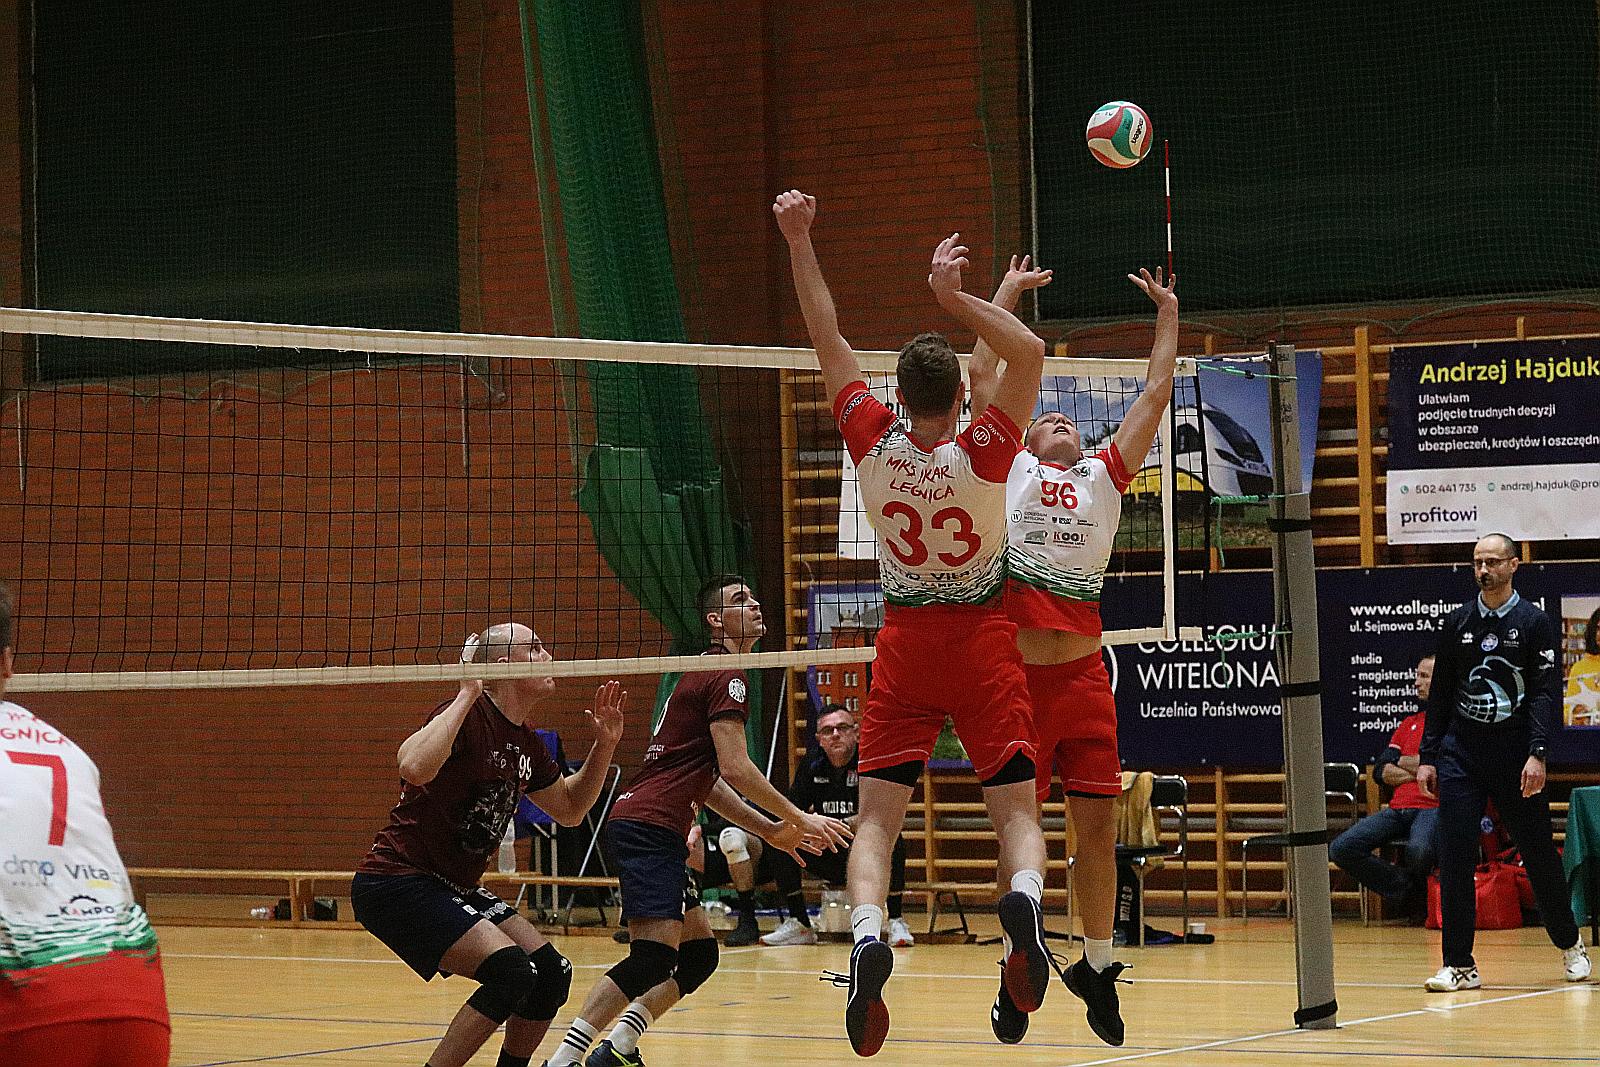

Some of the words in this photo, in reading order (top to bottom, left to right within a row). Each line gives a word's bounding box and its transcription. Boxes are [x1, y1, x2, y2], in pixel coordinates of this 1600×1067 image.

[1419, 359, 1507, 385] Andrzej
[1515, 356, 1600, 383] Hajduk
[1418, 408, 1467, 423] podjęcie
[1468, 406, 1515, 420] trudnych
[1517, 403, 1556, 418] decyzji
[1418, 427, 1428, 436] w
[1429, 424, 1479, 436] obszarze
[1418, 437, 1491, 453] ubezpieczeń,
[1491, 435, 1540, 450] kredytów
[1542, 435, 1546, 446] i
[886, 456, 916, 477] MKS
[918, 464, 956, 484] IKAR
[889, 478, 955, 504] LEGNICA
[1040, 480, 1079, 510] 96
[1415, 484, 1436, 494] 502
[1438, 483, 1457, 493] 441
[1459, 482, 1477, 492] 735
[1400, 505, 1478, 527] profitowi
[882, 500, 982, 567] 33
[1349, 620, 1363, 632] ul.
[1364, 620, 1414, 635] Sejmowa
[1416, 619, 1436, 632] 5A,
[1351, 652, 1382, 665] studia
[1137, 660, 1281, 690] WITELONA
[1140, 701, 1198, 718] Uczelnia
[1202, 700, 1282, 717] Państwowa
[1359, 701, 1419, 716] licencjackie
[6, 750, 68, 847] 7
